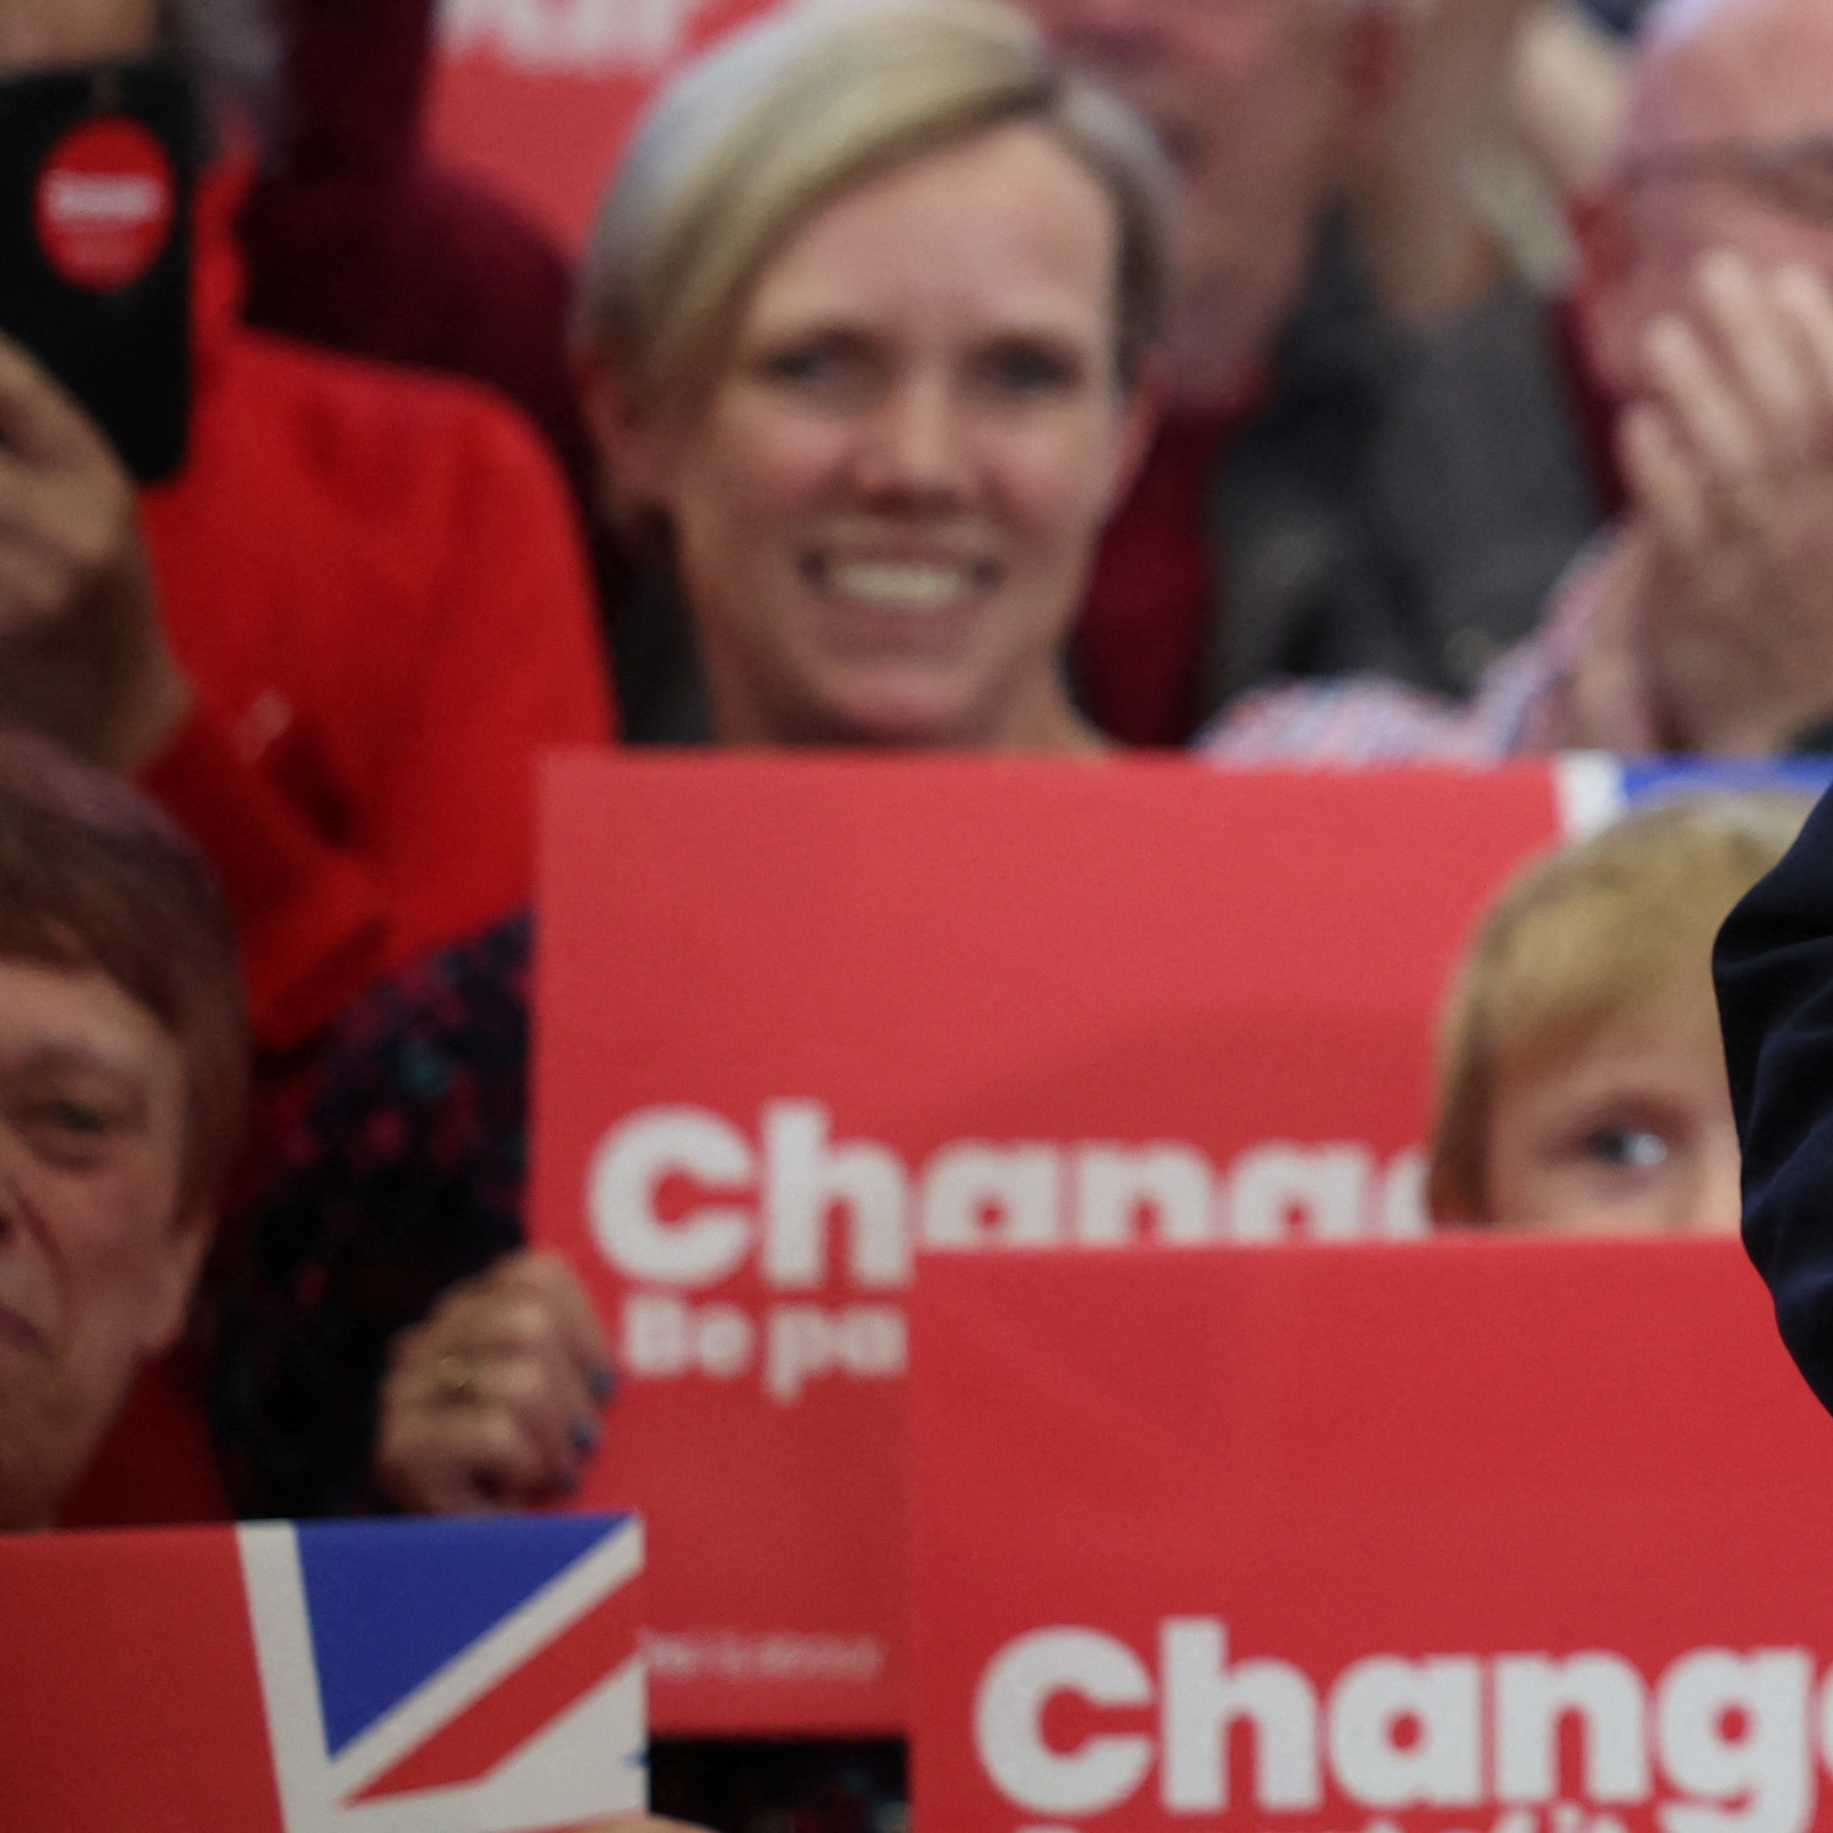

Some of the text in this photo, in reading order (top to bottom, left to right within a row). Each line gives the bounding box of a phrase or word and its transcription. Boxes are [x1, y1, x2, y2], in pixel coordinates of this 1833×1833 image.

[588, 1100, 1432, 1291] Chan
[624, 1291, 908, 1404] Be pa
